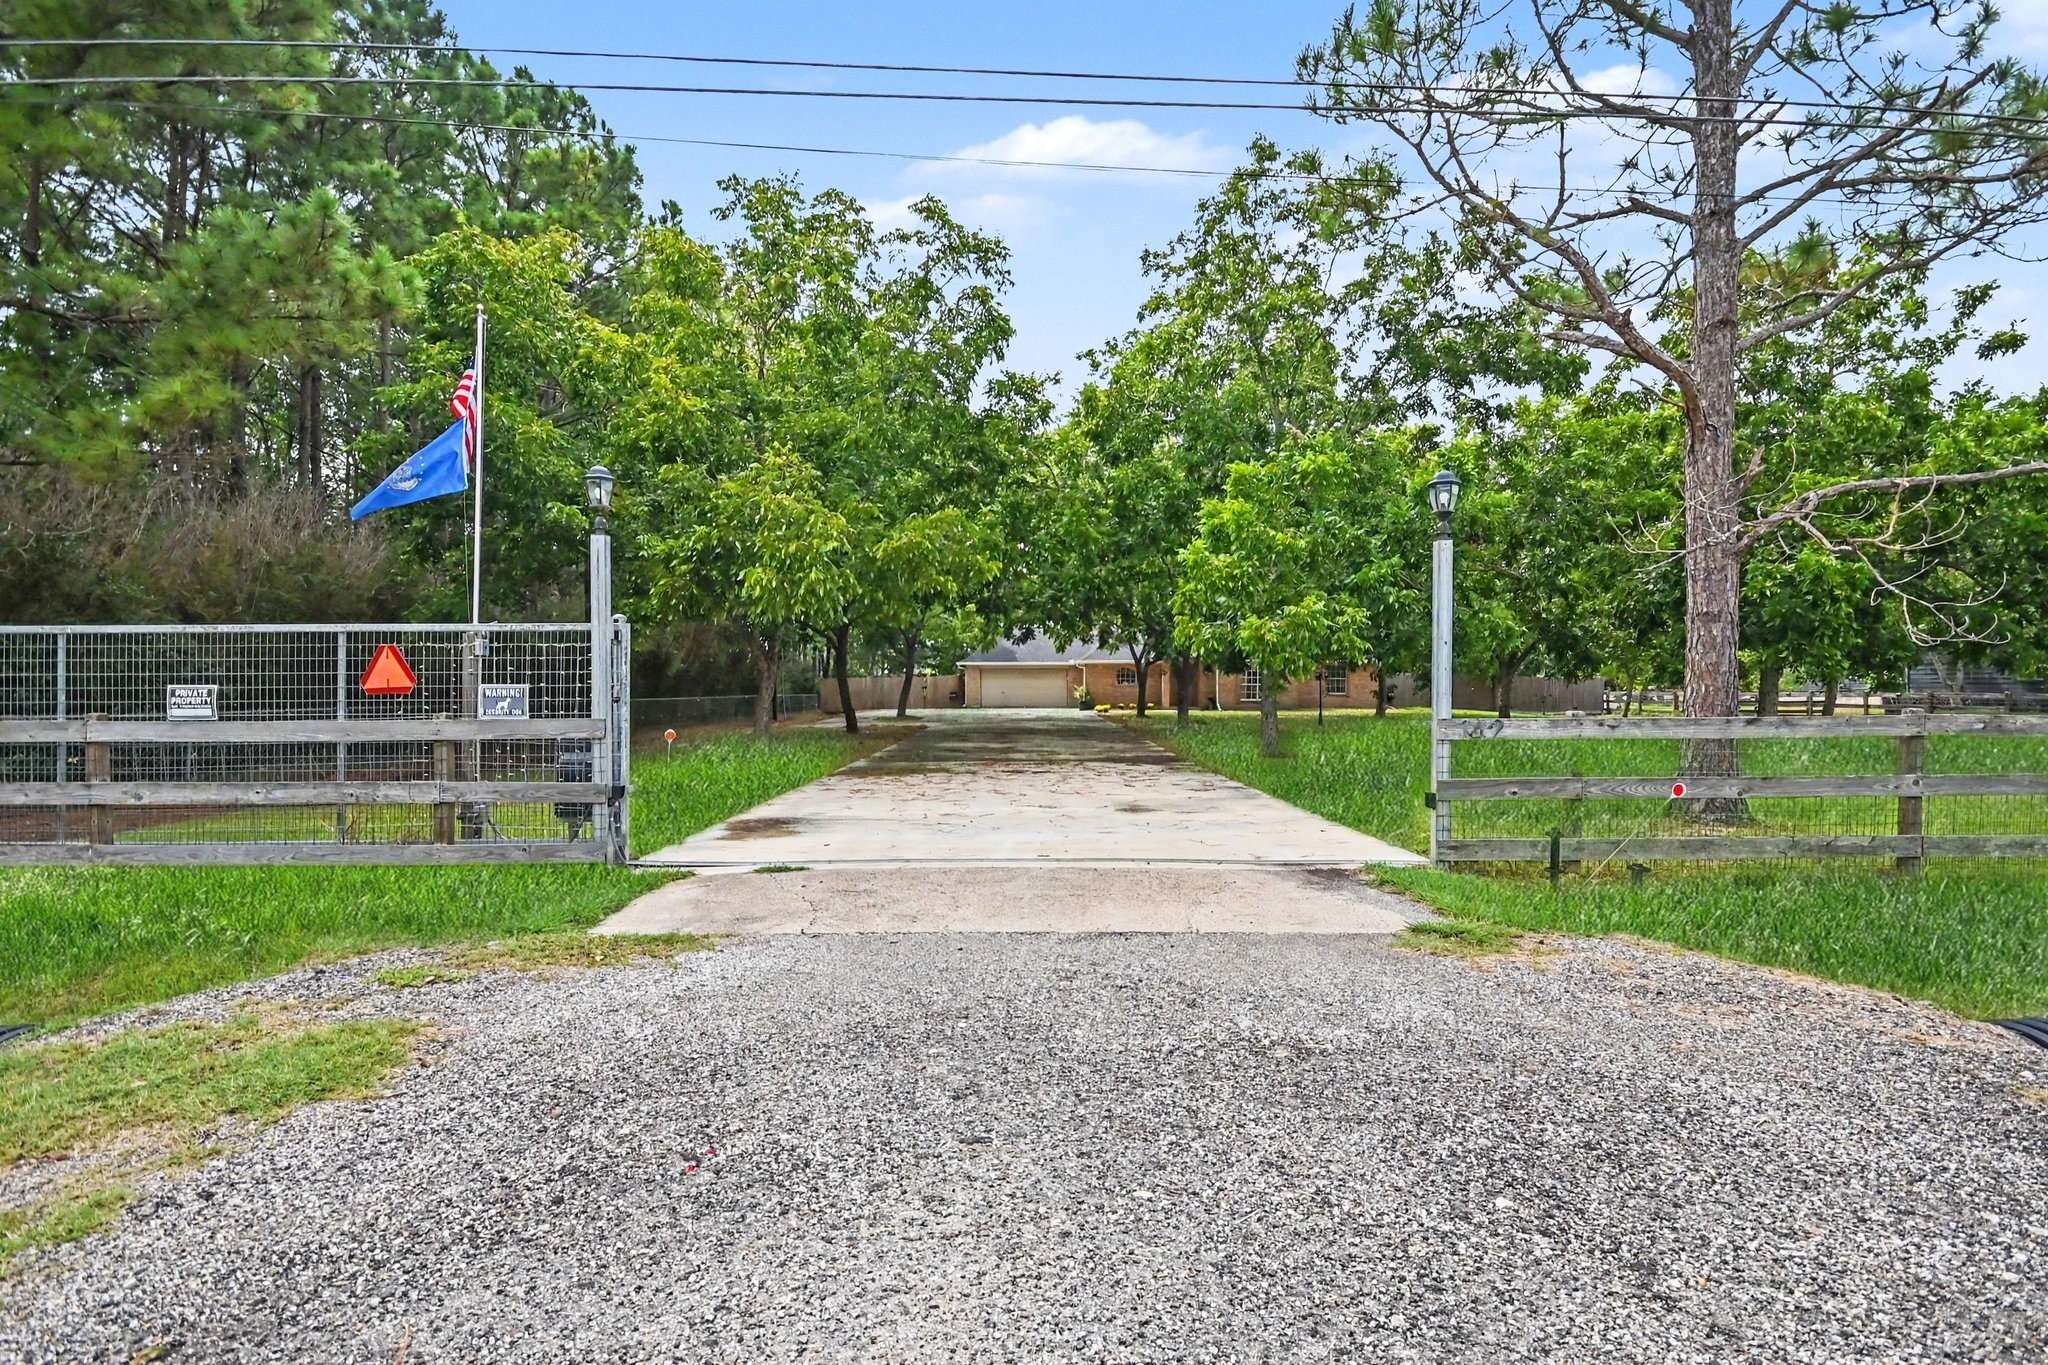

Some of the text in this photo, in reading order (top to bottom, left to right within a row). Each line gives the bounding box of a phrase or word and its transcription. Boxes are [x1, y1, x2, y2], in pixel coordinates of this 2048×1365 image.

[175, 689, 208, 697] PRIVATE
[485, 688, 523, 698] WARNING!
[171, 697, 211, 705] PROPERTY
